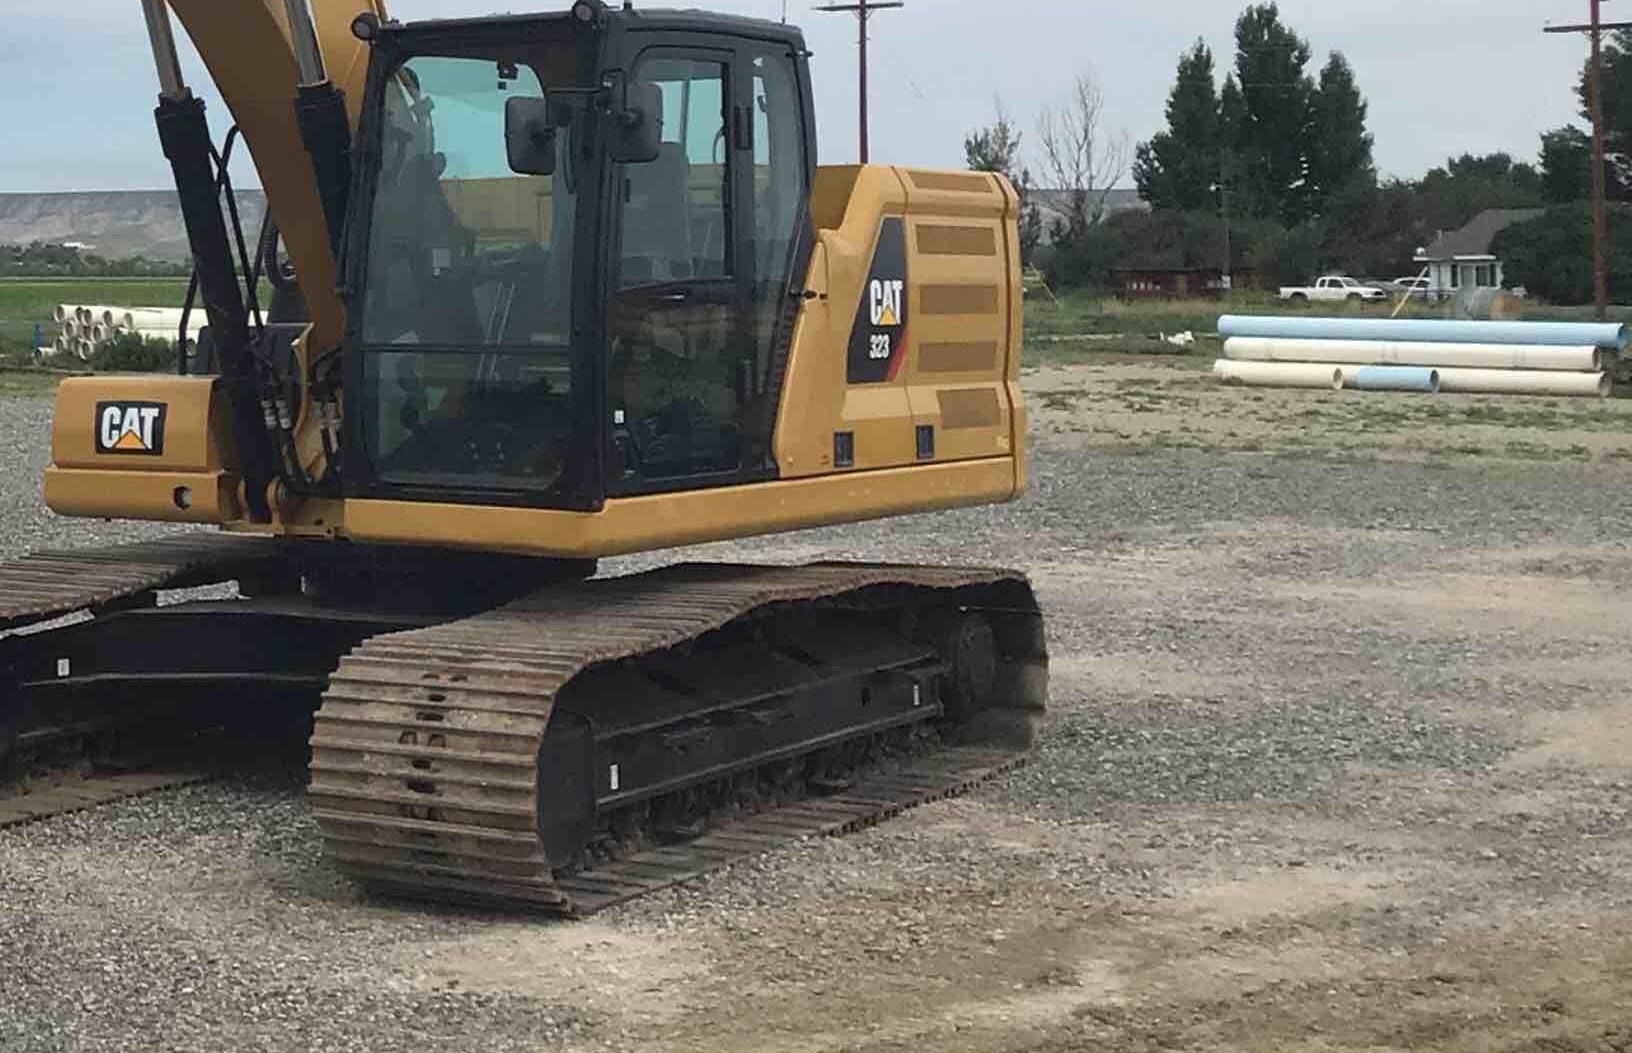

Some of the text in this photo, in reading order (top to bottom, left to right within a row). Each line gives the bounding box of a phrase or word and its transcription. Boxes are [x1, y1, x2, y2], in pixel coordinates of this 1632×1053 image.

[870, 279, 903, 325] CAT
[870, 334, 890, 358] 323
[101, 406, 159, 450] CAT
